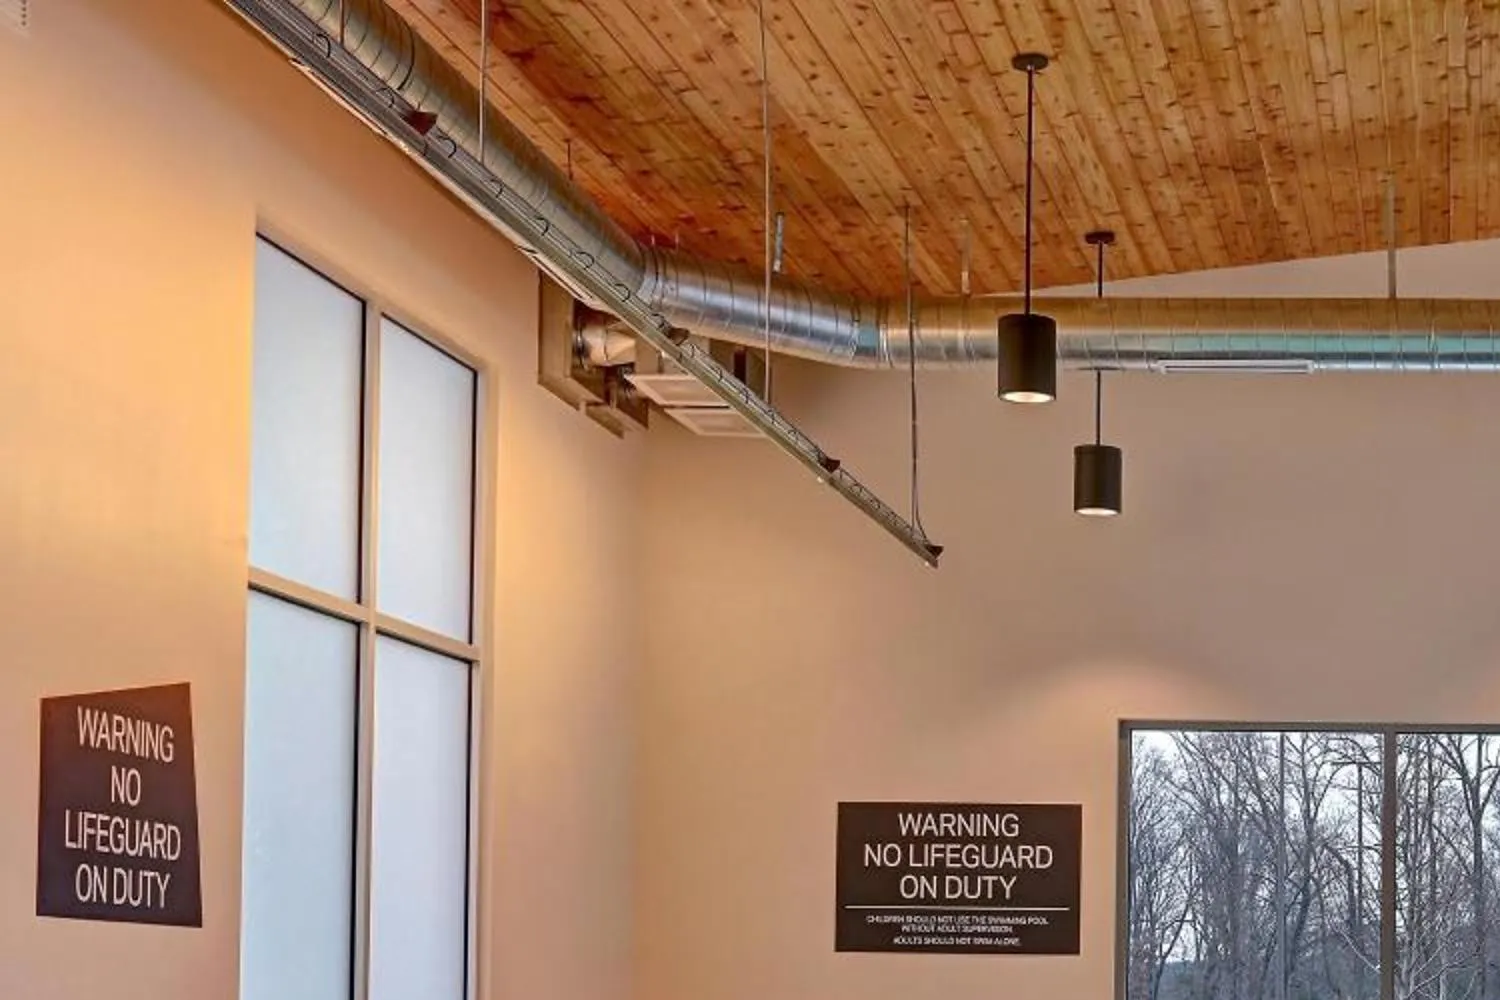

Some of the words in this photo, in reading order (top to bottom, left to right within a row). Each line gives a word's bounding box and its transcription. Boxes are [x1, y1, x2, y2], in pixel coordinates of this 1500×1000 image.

[77, 706, 174, 763] WARNING
[111, 765, 141, 806] NO
[65, 809, 181, 861] LIFEGUARD
[898, 813, 1019, 837] WARNING
[864, 843, 902, 867] NO
[909, 843, 1053, 869] LIFEGUARD
[75, 863, 108, 903] ON
[113, 867, 171, 908] DUTY
[899, 874, 938, 899] ON
[945, 875, 1017, 899] DUTY
